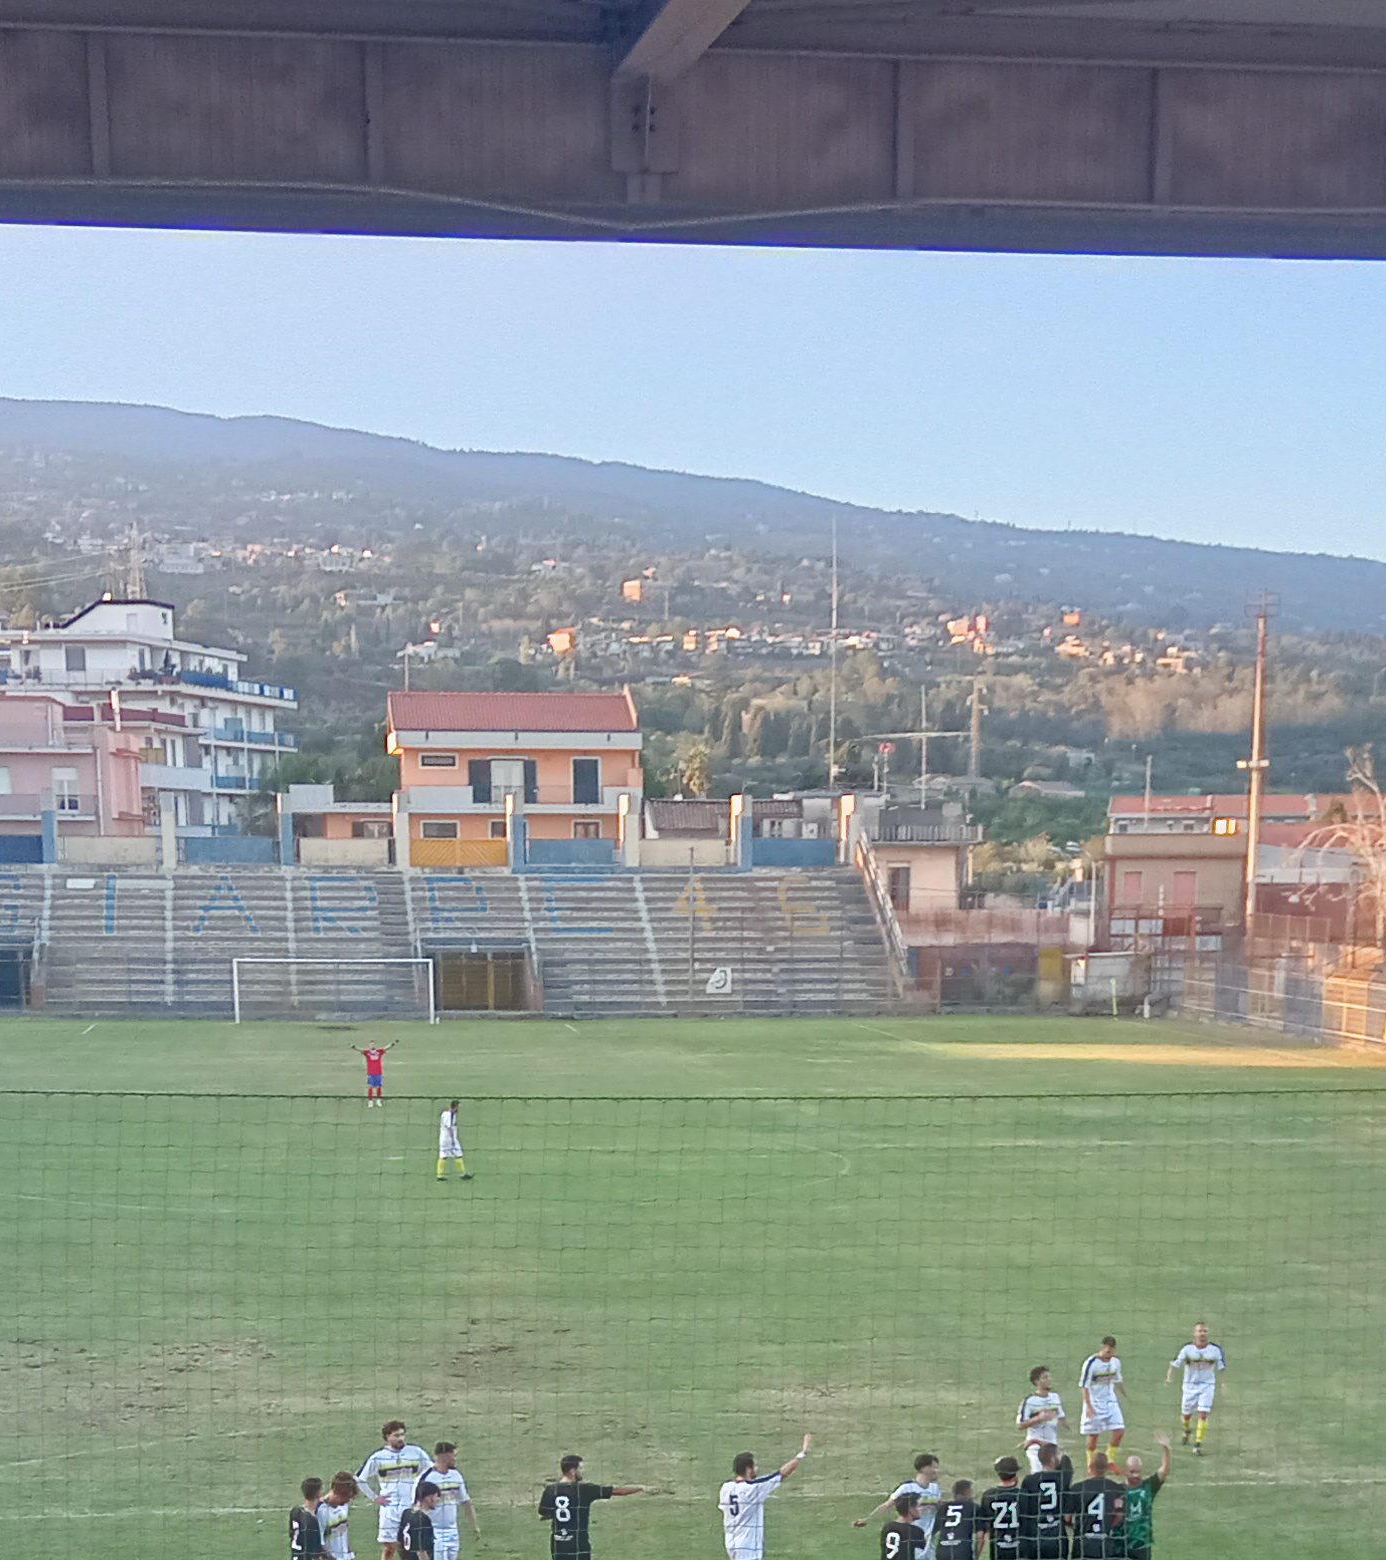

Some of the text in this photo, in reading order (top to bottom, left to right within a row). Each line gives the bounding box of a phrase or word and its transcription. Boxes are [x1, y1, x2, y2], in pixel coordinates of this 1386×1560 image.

[555, 1496, 571, 1522] 8
[729, 1494, 740, 1517] 5
[1039, 1481, 1058, 1510] 3
[1087, 1493, 1105, 1520] 4
[944, 1505, 963, 1527] 5
[991, 1501, 1020, 1529] 21
[885, 1532, 901, 1560] 9
